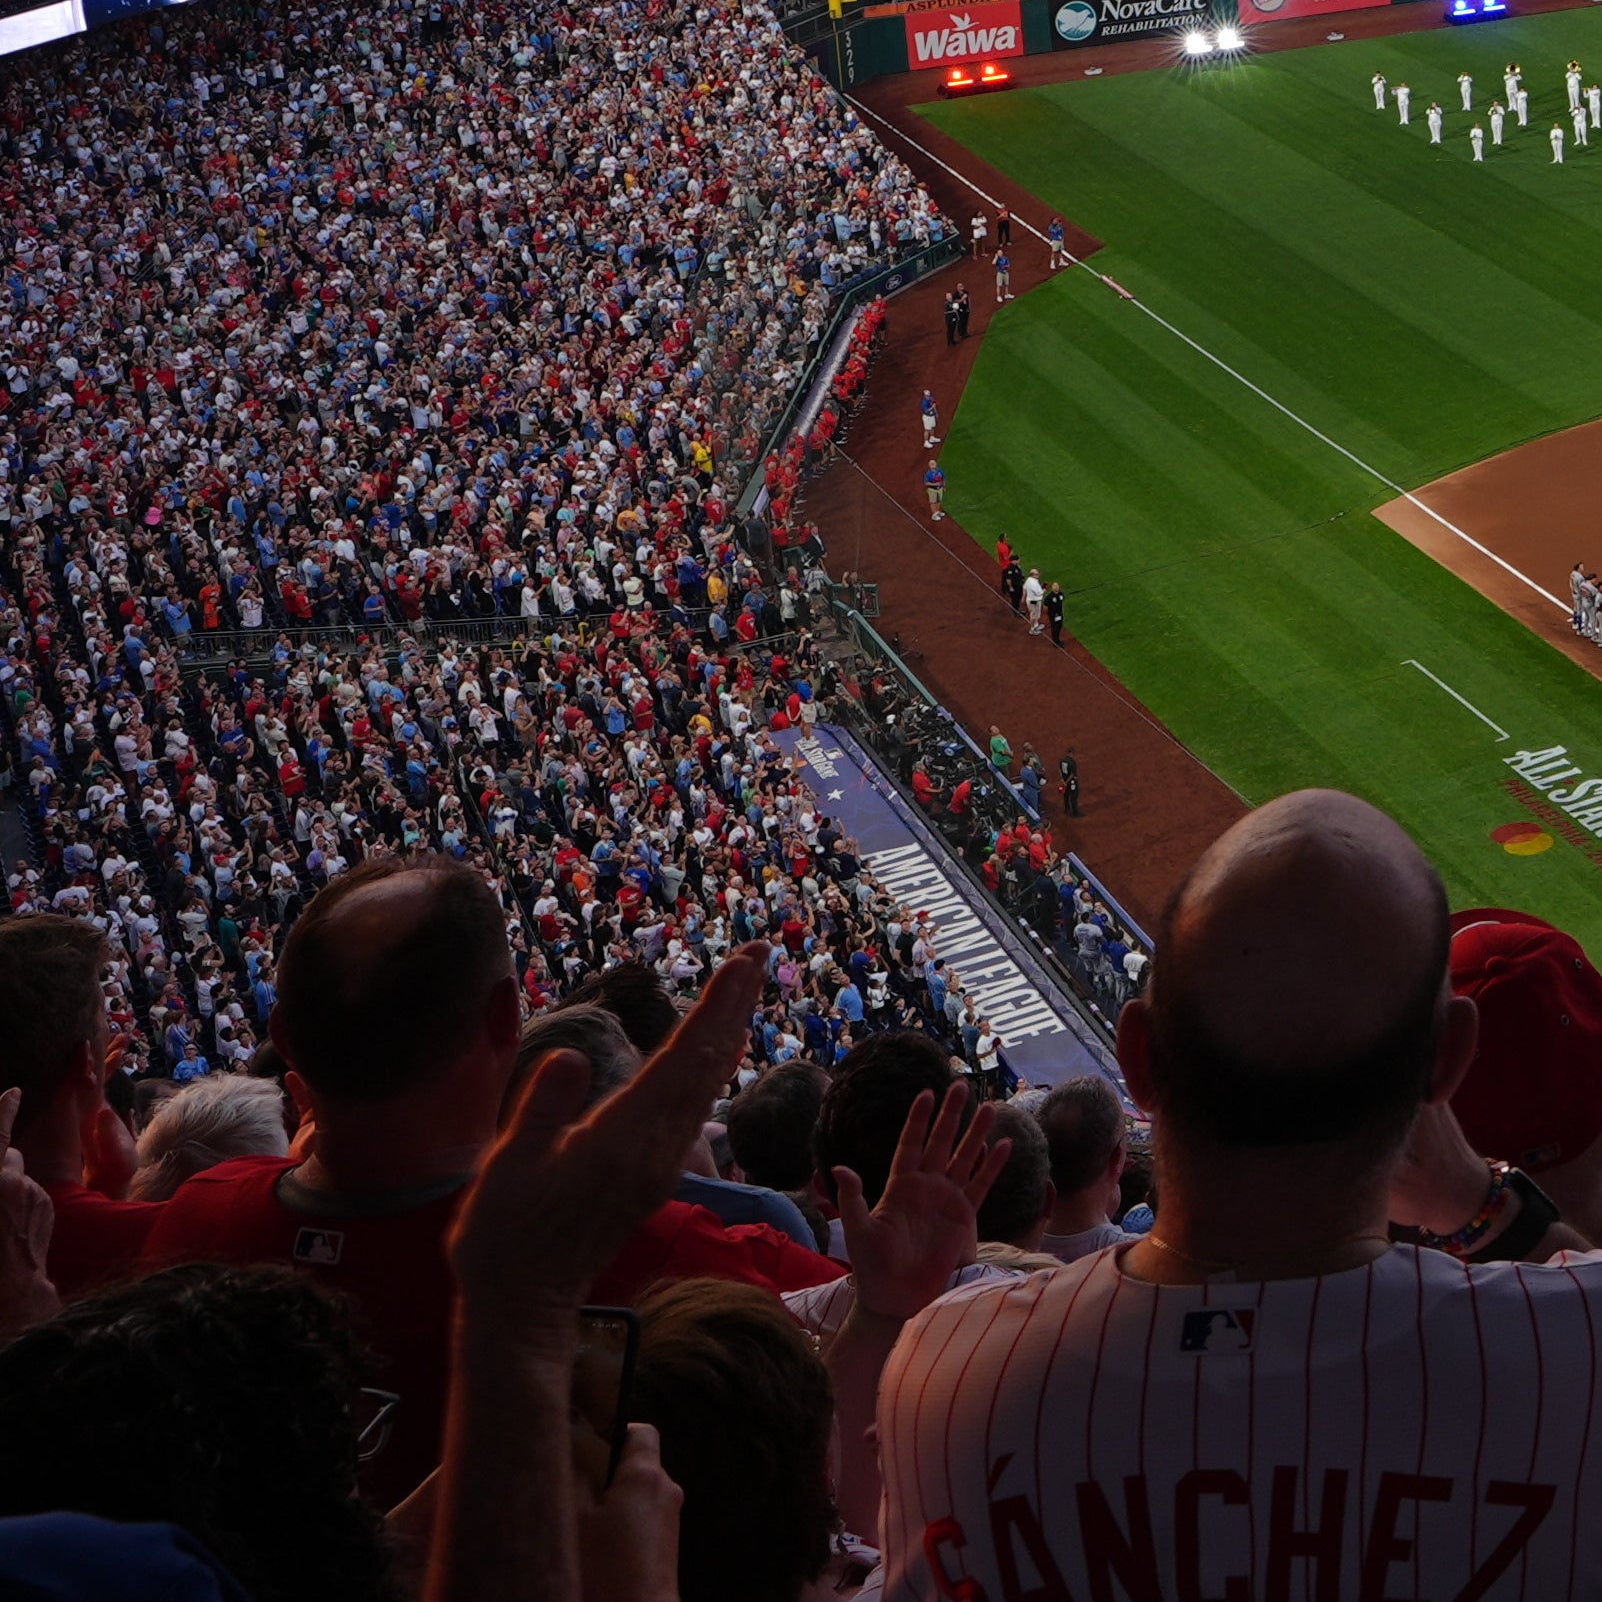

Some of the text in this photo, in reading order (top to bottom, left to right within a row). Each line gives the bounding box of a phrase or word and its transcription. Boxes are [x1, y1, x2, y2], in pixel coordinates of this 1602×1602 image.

[914, 25, 1016, 62] Wawa
[1101, 13, 1205, 37] REHABILITATION
[844, 31, 855, 83] 329
[1502, 745, 1583, 791] ALL
[1503, 779, 1592, 847] PHILADELPHIA
[858, 842, 1068, 1050] AMERICAN LEAGUE
[924, 1453, 1559, 1602] SÁNCHEZ
